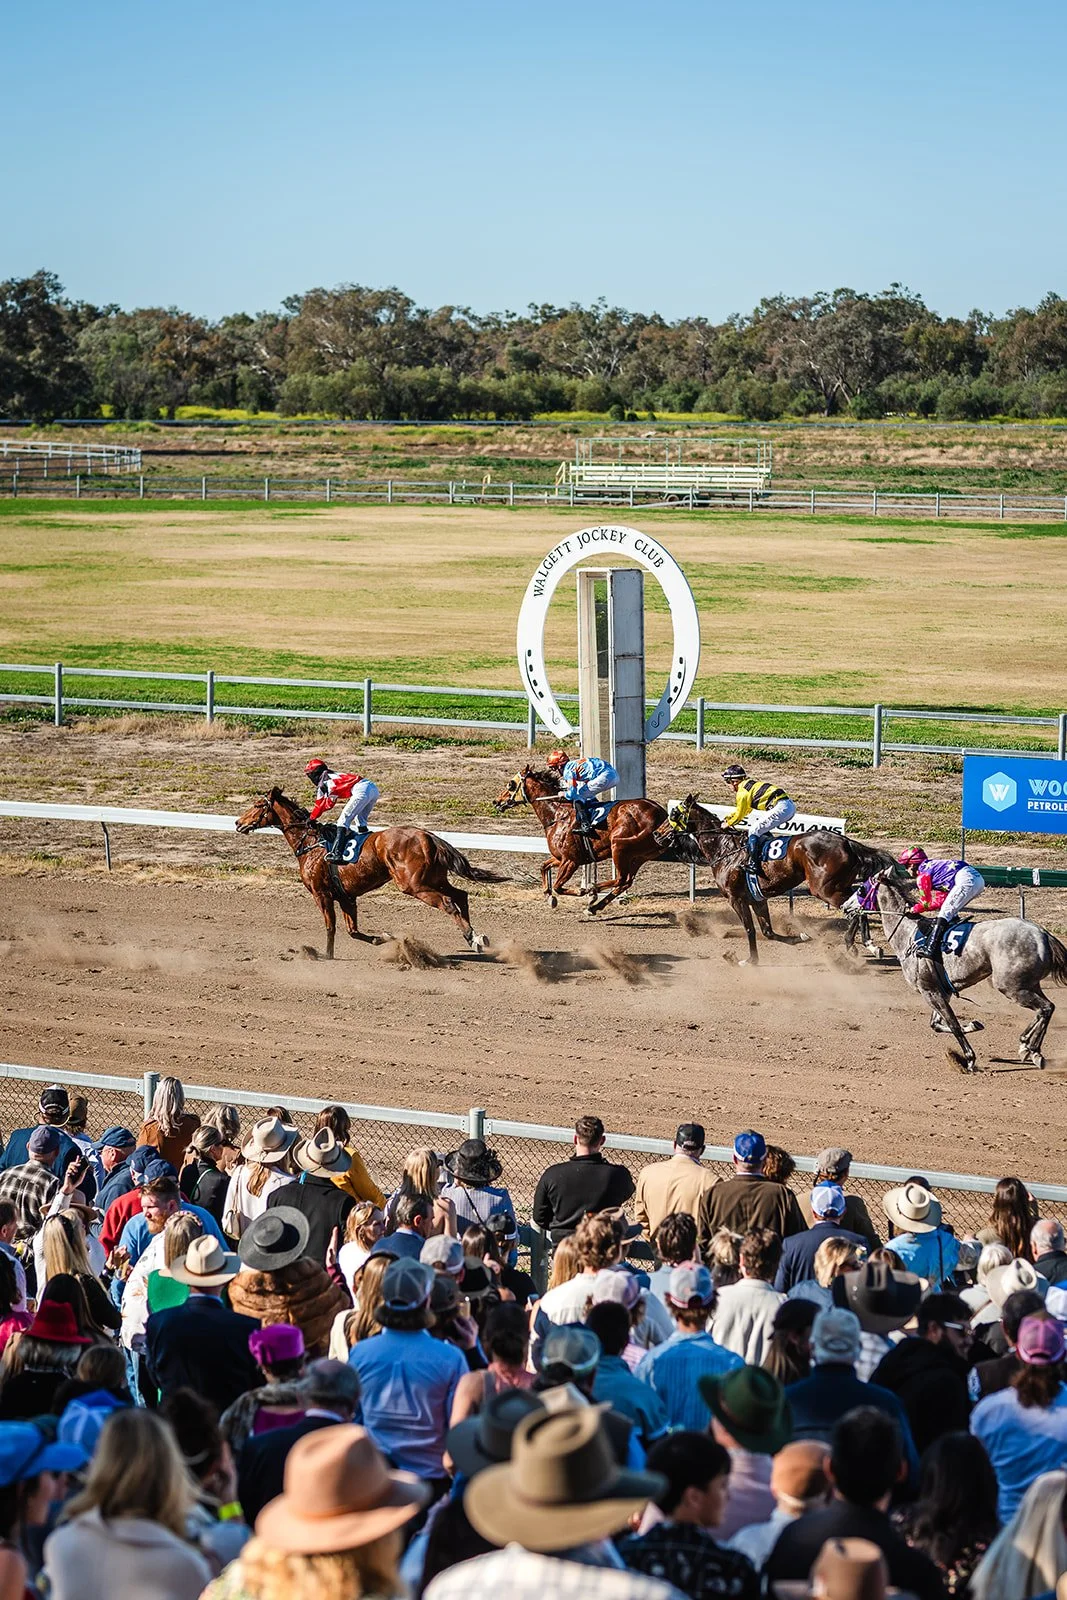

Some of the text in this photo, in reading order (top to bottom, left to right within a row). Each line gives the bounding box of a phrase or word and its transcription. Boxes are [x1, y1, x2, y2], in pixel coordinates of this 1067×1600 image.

[533, 528, 664, 597] WALGETT JOCKEY CLUB
[988, 783, 1010, 802] W
[1028, 778, 1067, 797] WO
[590, 807, 605, 826] 2
[342, 839, 357, 861] 3
[768, 839, 783, 860] 8
[947, 930, 964, 950] 5
